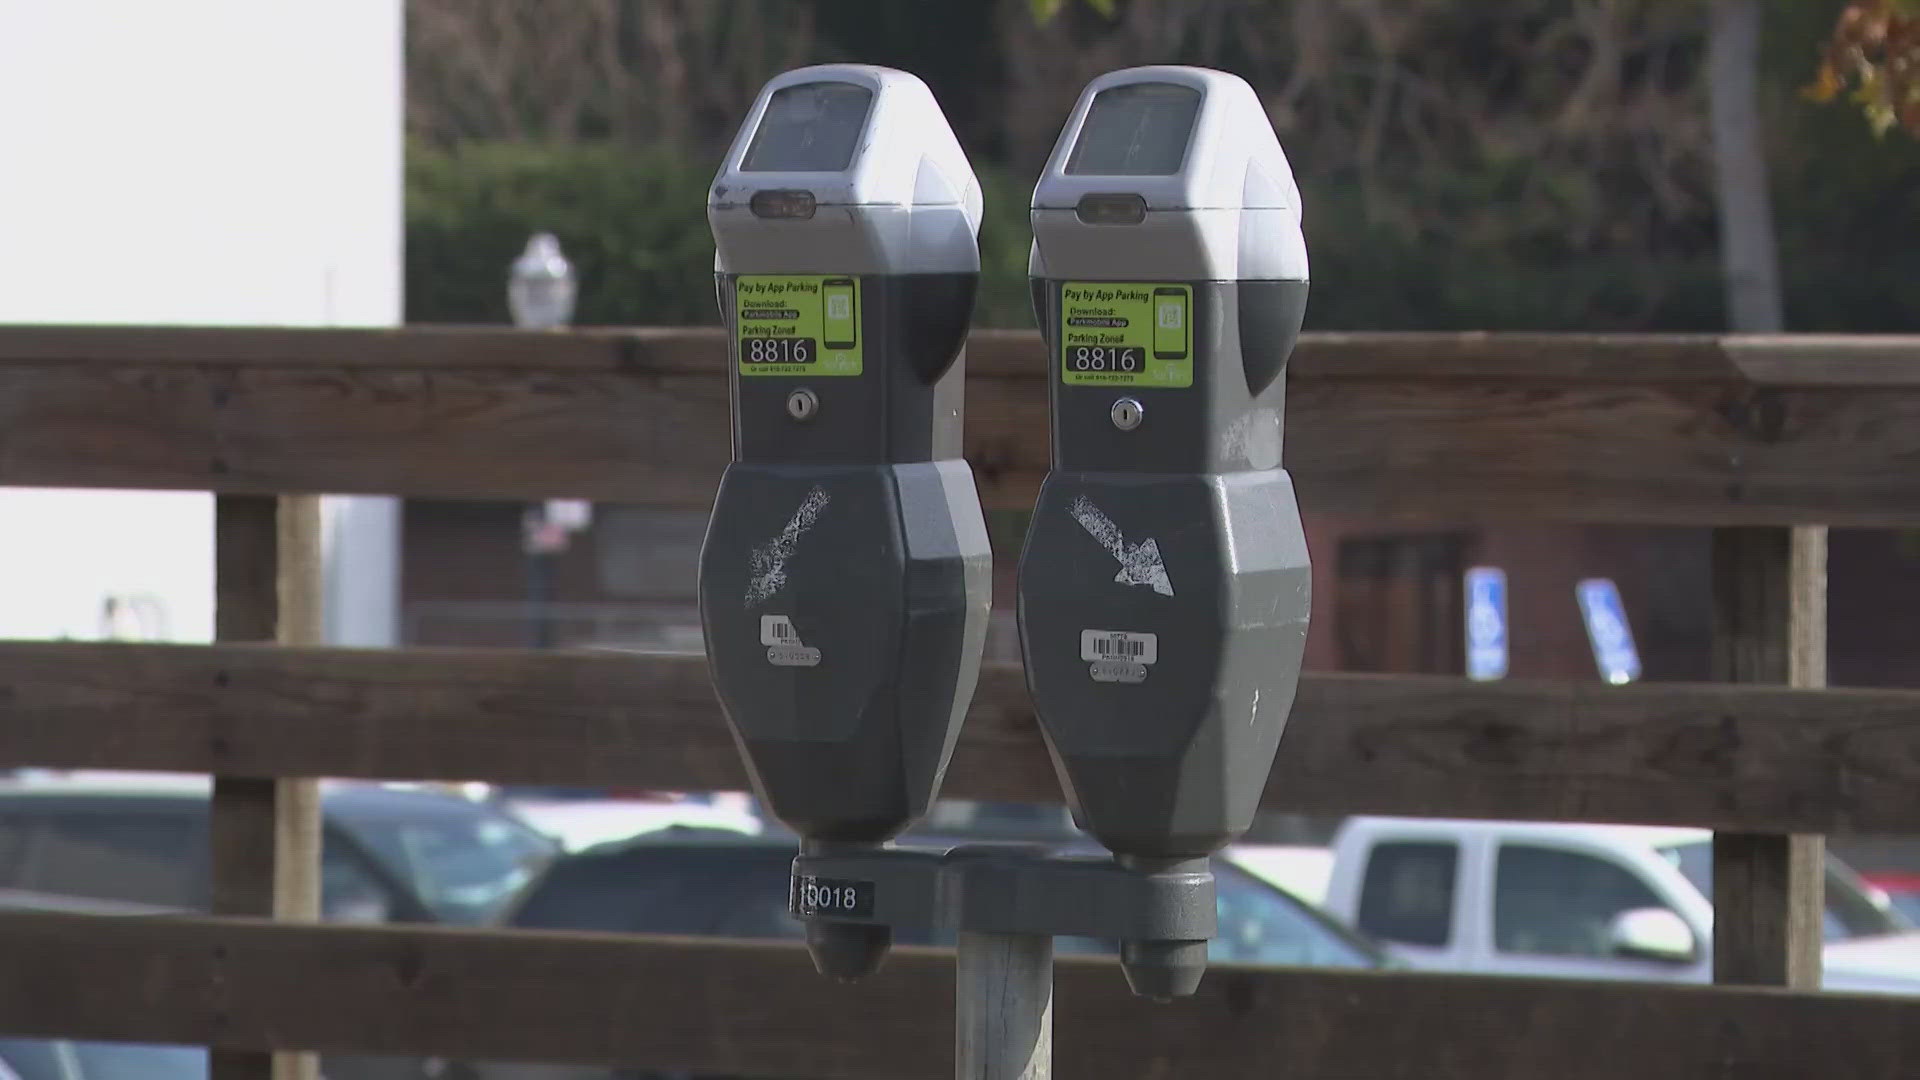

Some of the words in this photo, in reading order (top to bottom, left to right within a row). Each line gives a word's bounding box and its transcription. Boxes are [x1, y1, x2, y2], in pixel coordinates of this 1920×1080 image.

[738, 282, 753, 294] Pay
[755, 282, 766, 294] by
[767, 283, 785, 294] App
[787, 283, 818, 294] Parking
[1065, 289, 1080, 300] Pay
[1083, 290, 1094, 301] by
[1096, 290, 1114, 301] App
[1116, 290, 1149, 303] Parking
[744, 300, 787, 308] Download:
[1070, 307, 1116, 316] Download:
[1112, 318, 1127, 328] App
[743, 326, 771, 337] Parking
[1068, 334, 1098, 344] Parking
[751, 339, 807, 362] 8816
[1076, 347, 1135, 371] 8816
